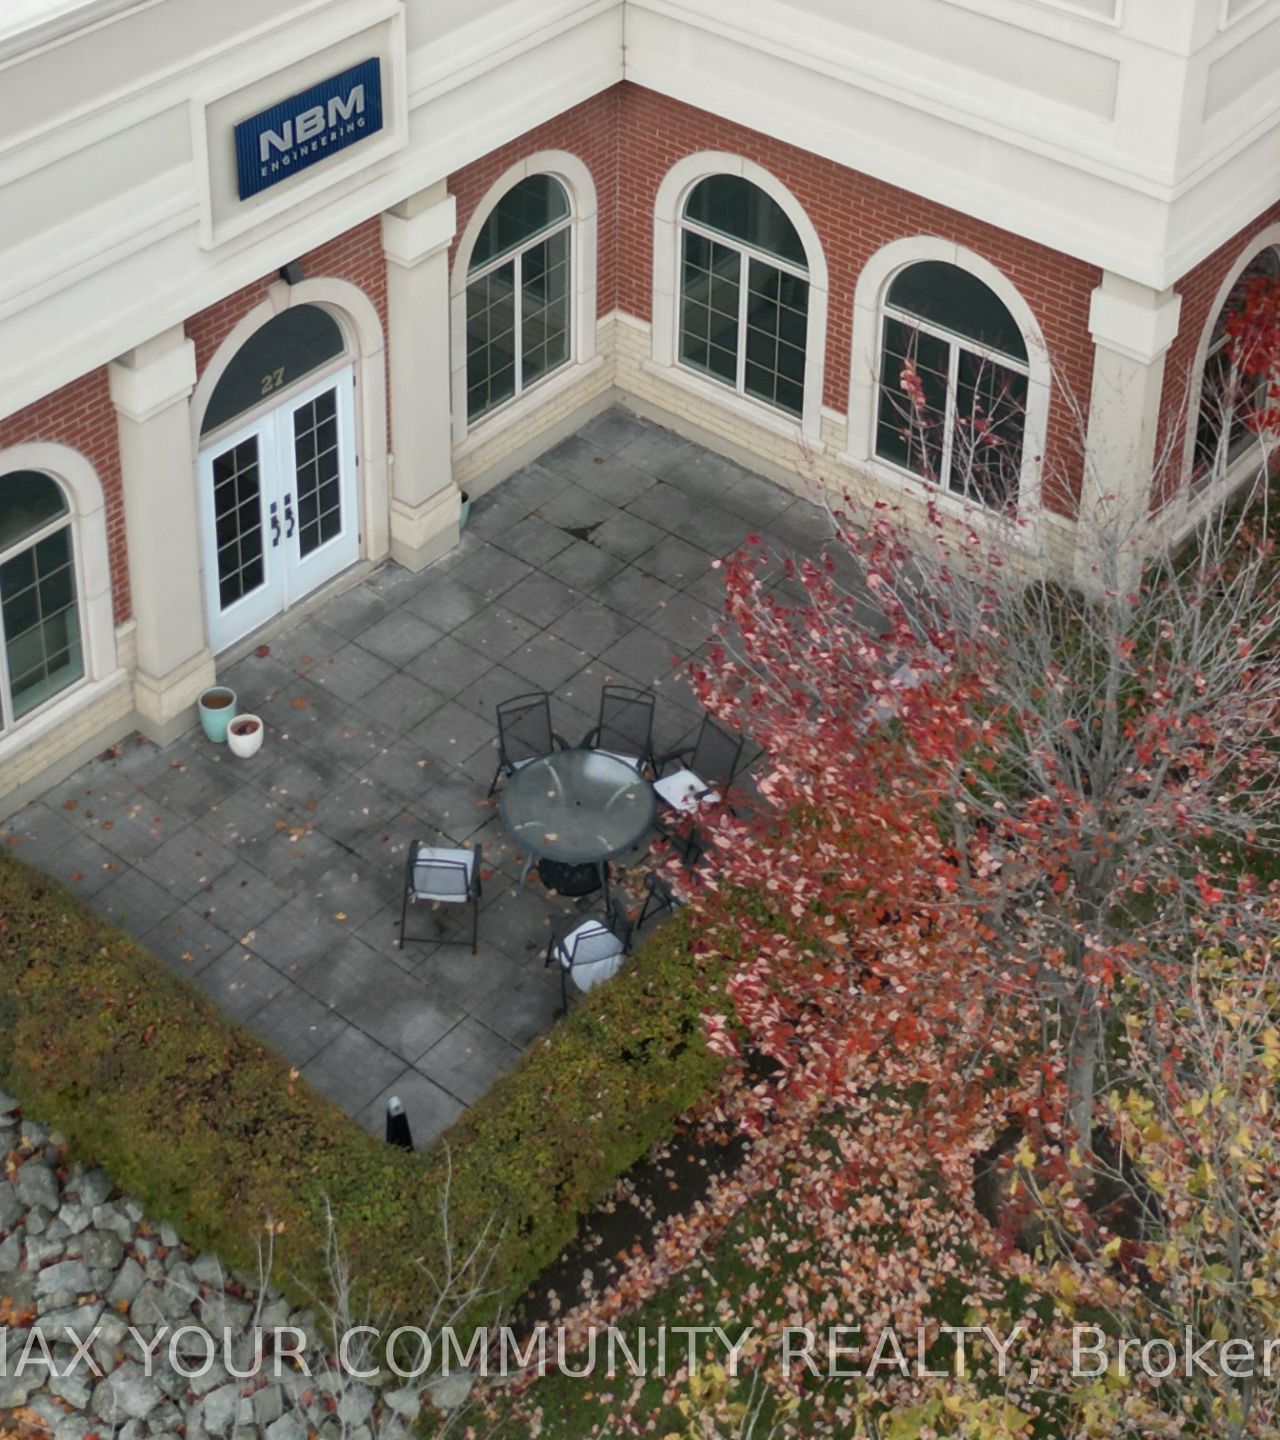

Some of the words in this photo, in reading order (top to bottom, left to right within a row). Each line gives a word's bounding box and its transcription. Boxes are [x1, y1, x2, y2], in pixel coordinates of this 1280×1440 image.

[259, 84, 365, 162] NBM
[261, 117, 365, 177] ENGINEERING
[260, 366, 286, 395] 27
